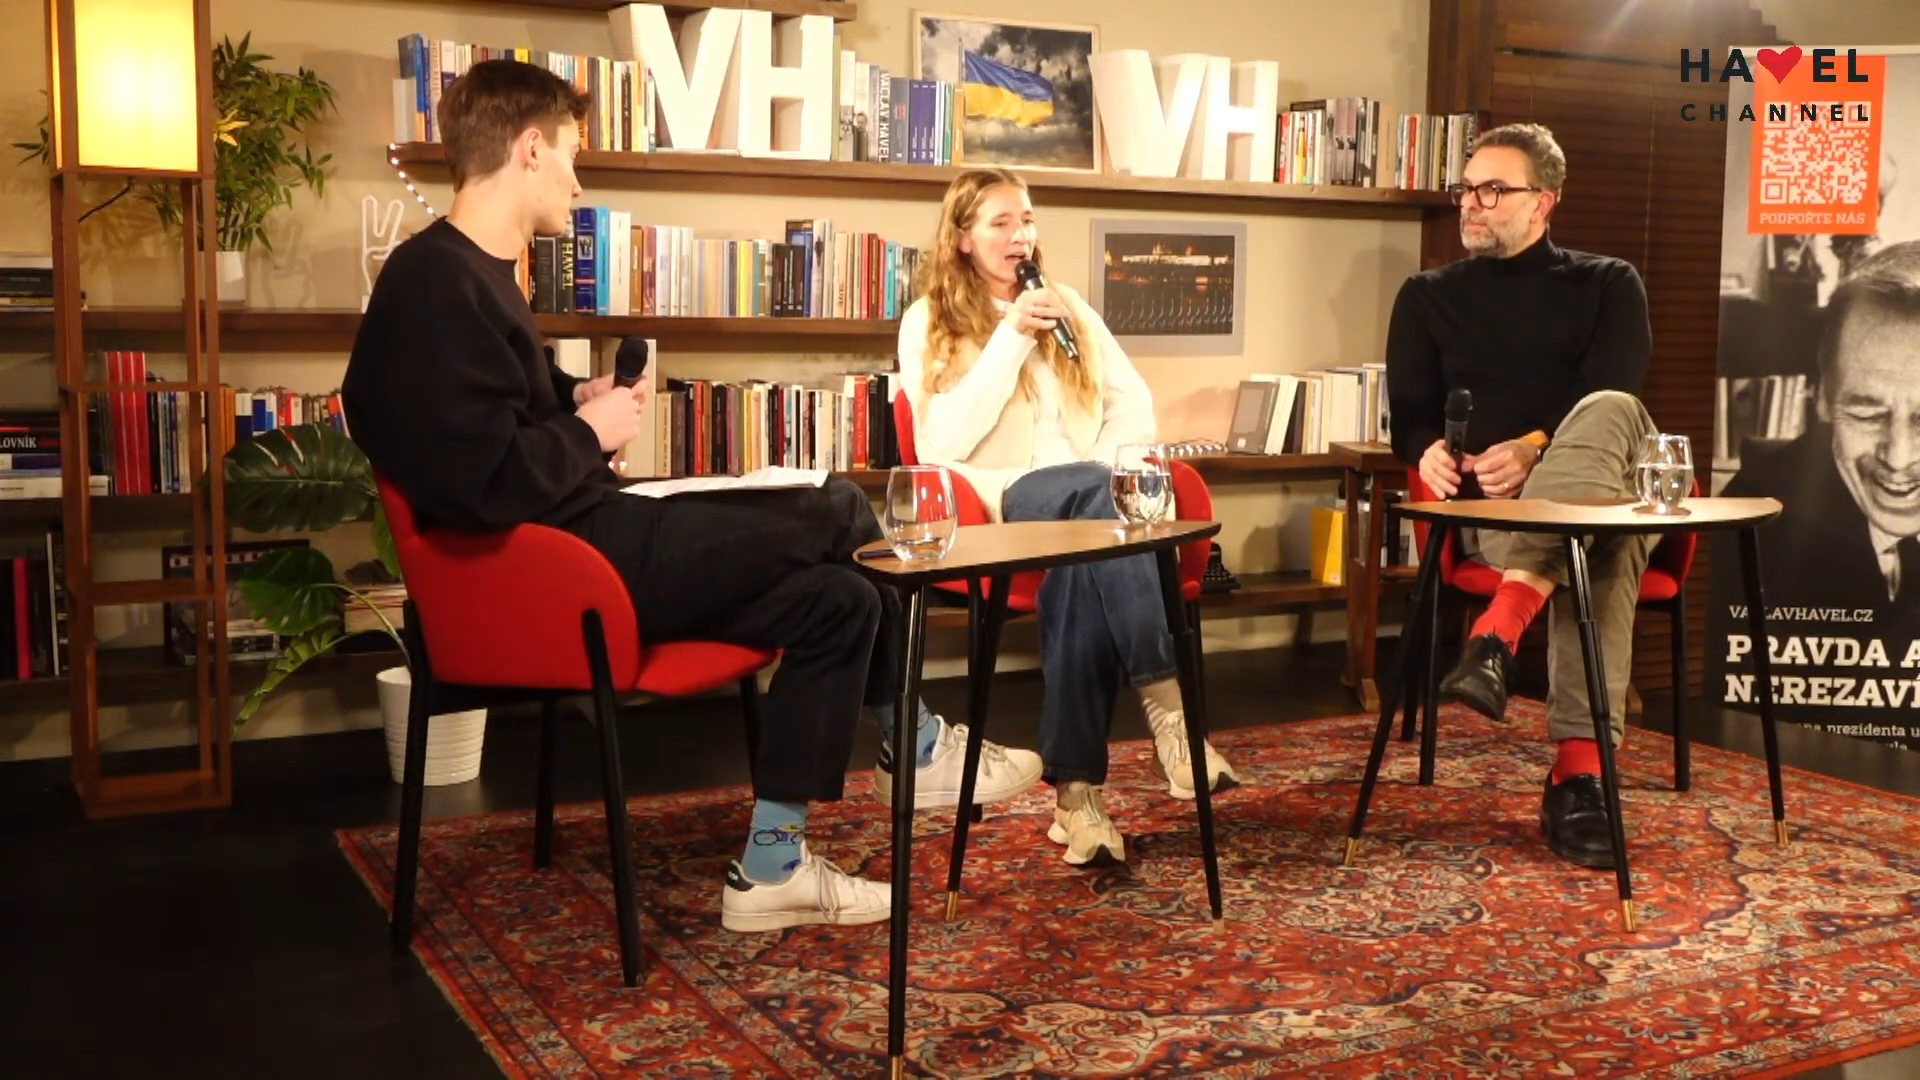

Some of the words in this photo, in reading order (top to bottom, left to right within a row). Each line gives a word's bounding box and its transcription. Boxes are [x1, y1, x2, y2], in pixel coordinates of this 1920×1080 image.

[612, 3, 835, 161] VH
[1090, 49, 1279, 182] VH
[879, 123, 889, 162] HAVEL
[1759, 211, 1832, 224] PODPOŘTE
[1836, 211, 1865, 224] NÁS
[562, 243, 574, 290] HAVEL
[1729, 605, 1874, 622] VAAVHAVEL.CZ
[1726, 635, 1890, 667] PRAVDA
[1900, 639, 1920, 668] A
